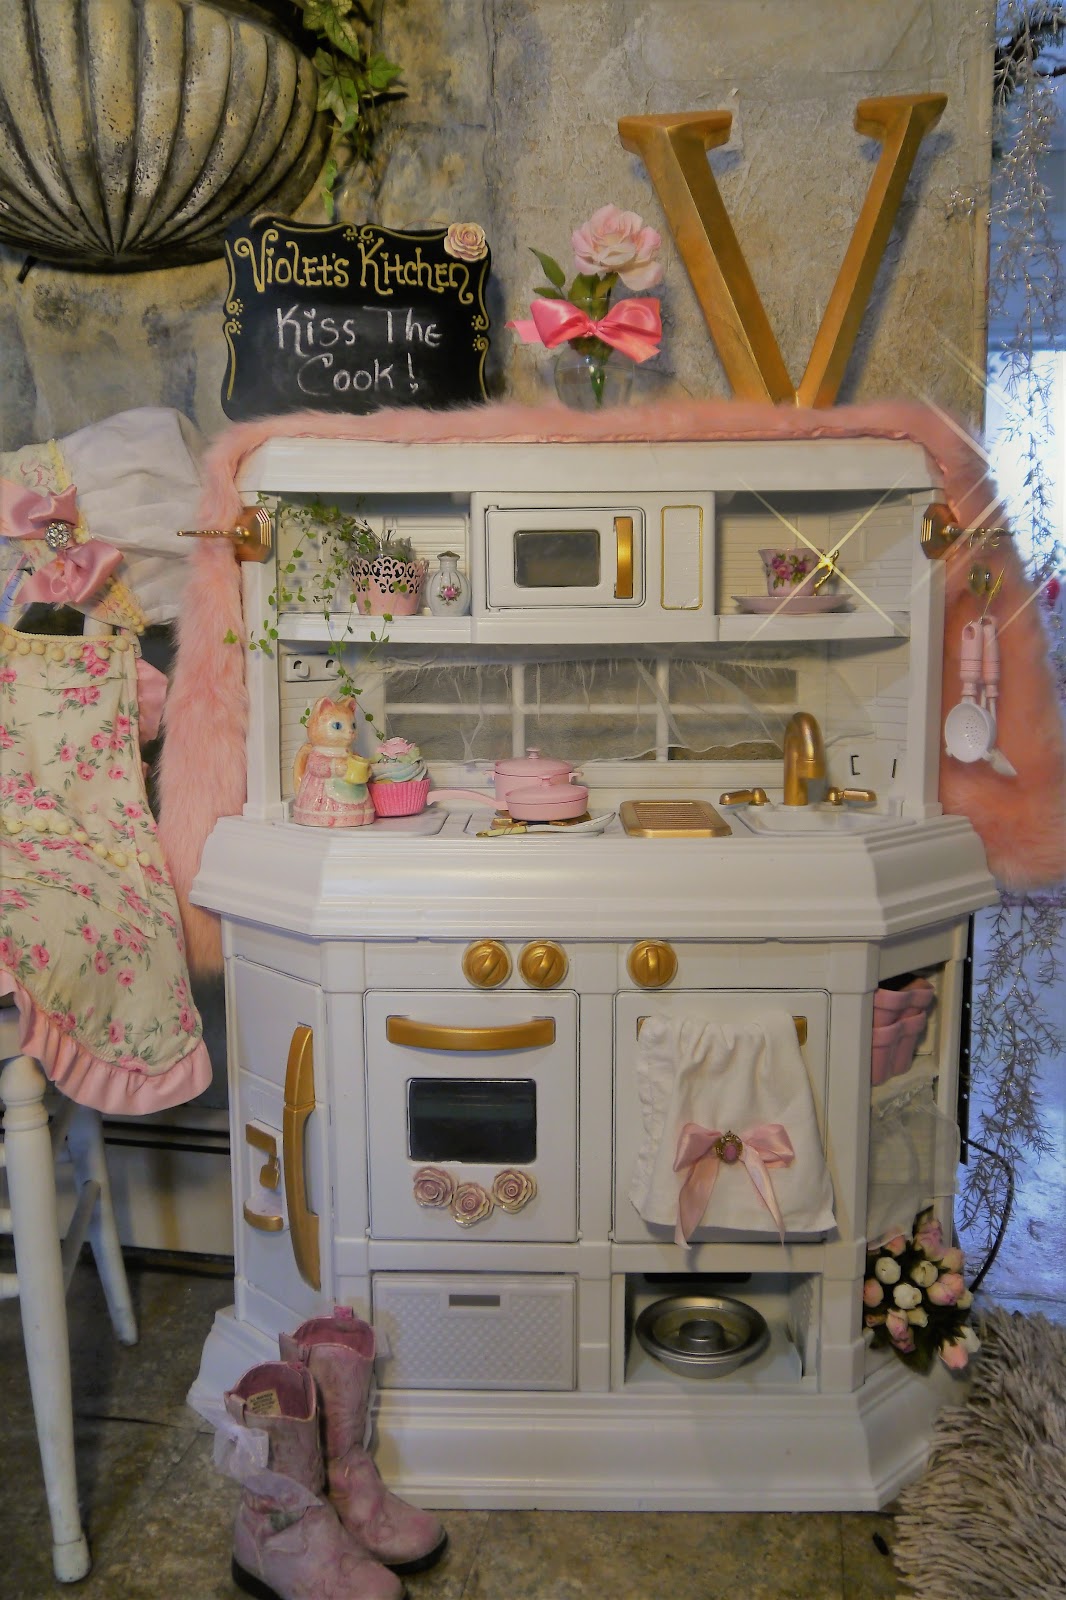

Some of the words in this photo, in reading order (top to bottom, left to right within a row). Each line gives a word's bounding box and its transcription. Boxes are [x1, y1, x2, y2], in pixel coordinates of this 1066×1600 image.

[357, 237, 474, 304] Kitchen
[618, 92, 948, 407] V
[276, 304, 356, 357] Kiss
[362, 305, 443, 348] The
